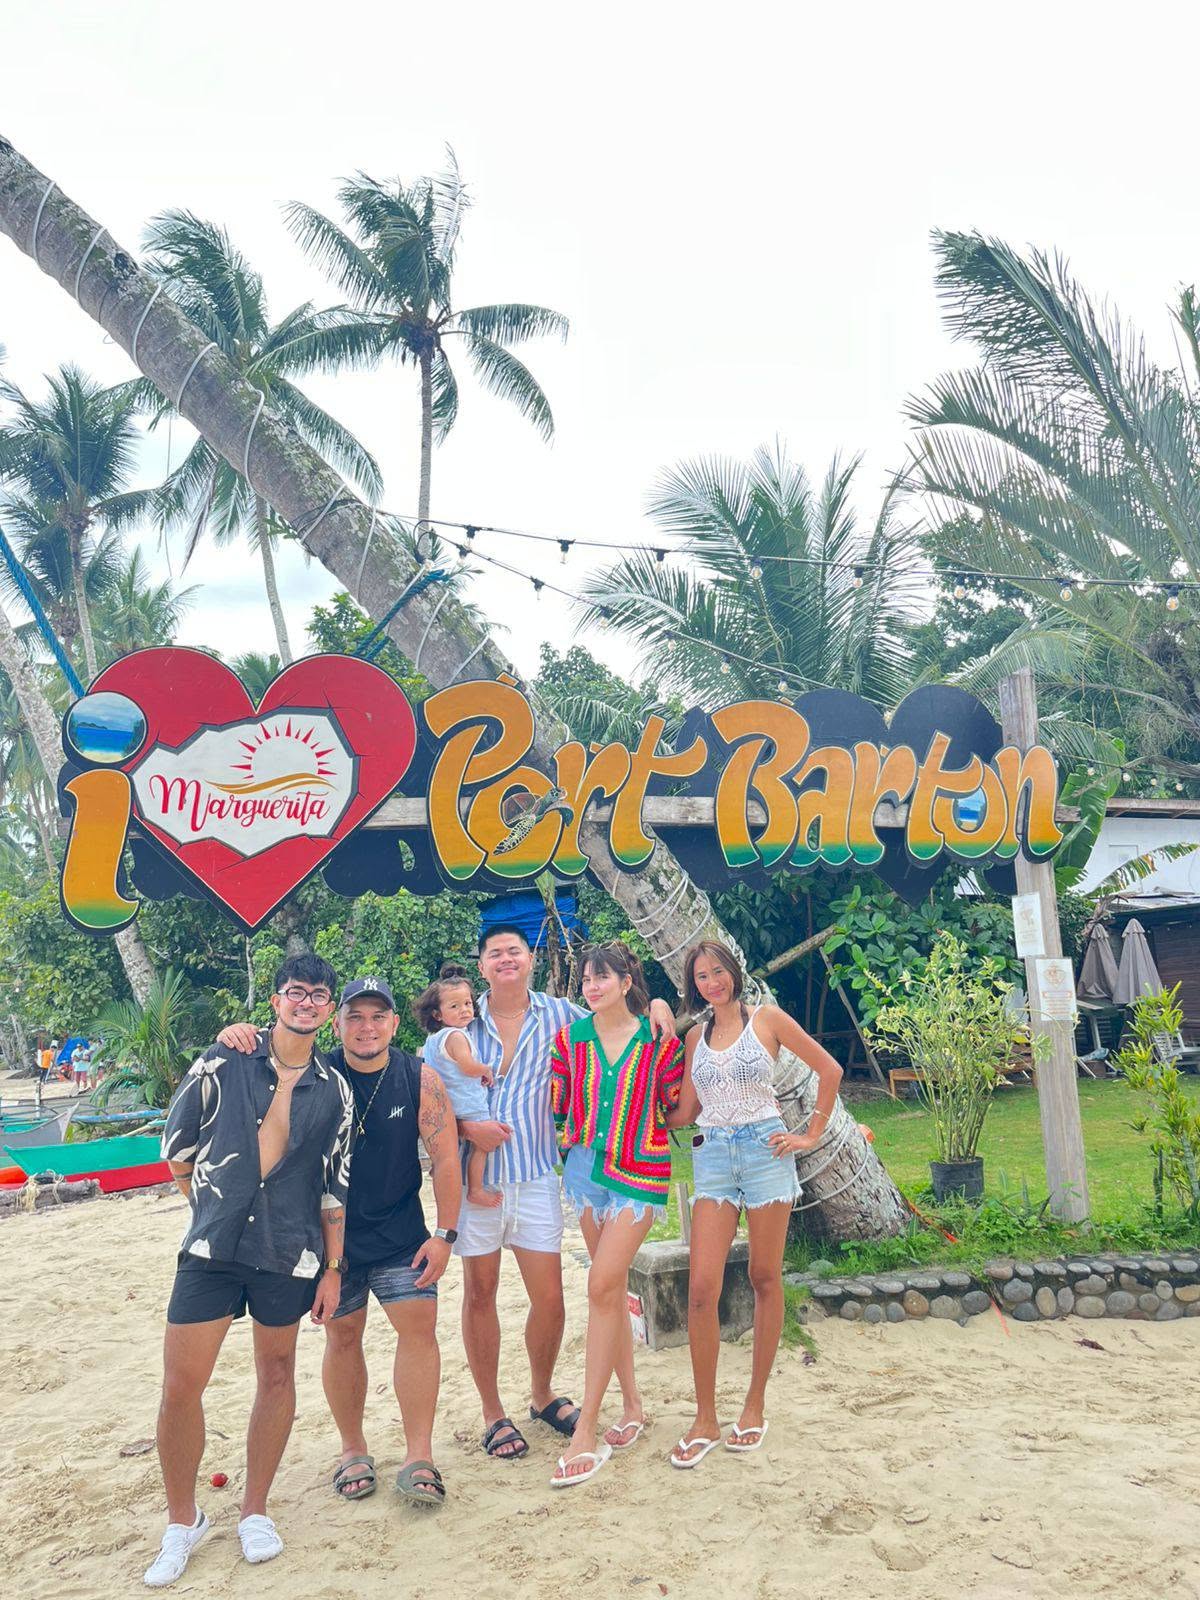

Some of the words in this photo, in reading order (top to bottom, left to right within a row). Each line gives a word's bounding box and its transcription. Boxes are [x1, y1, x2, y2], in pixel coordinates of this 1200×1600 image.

[149, 774, 331, 832] Marguerita
[424, 673, 706, 880] Port
[711, 698, 1063, 867] Barton
[363, 978, 378, 990] NY
